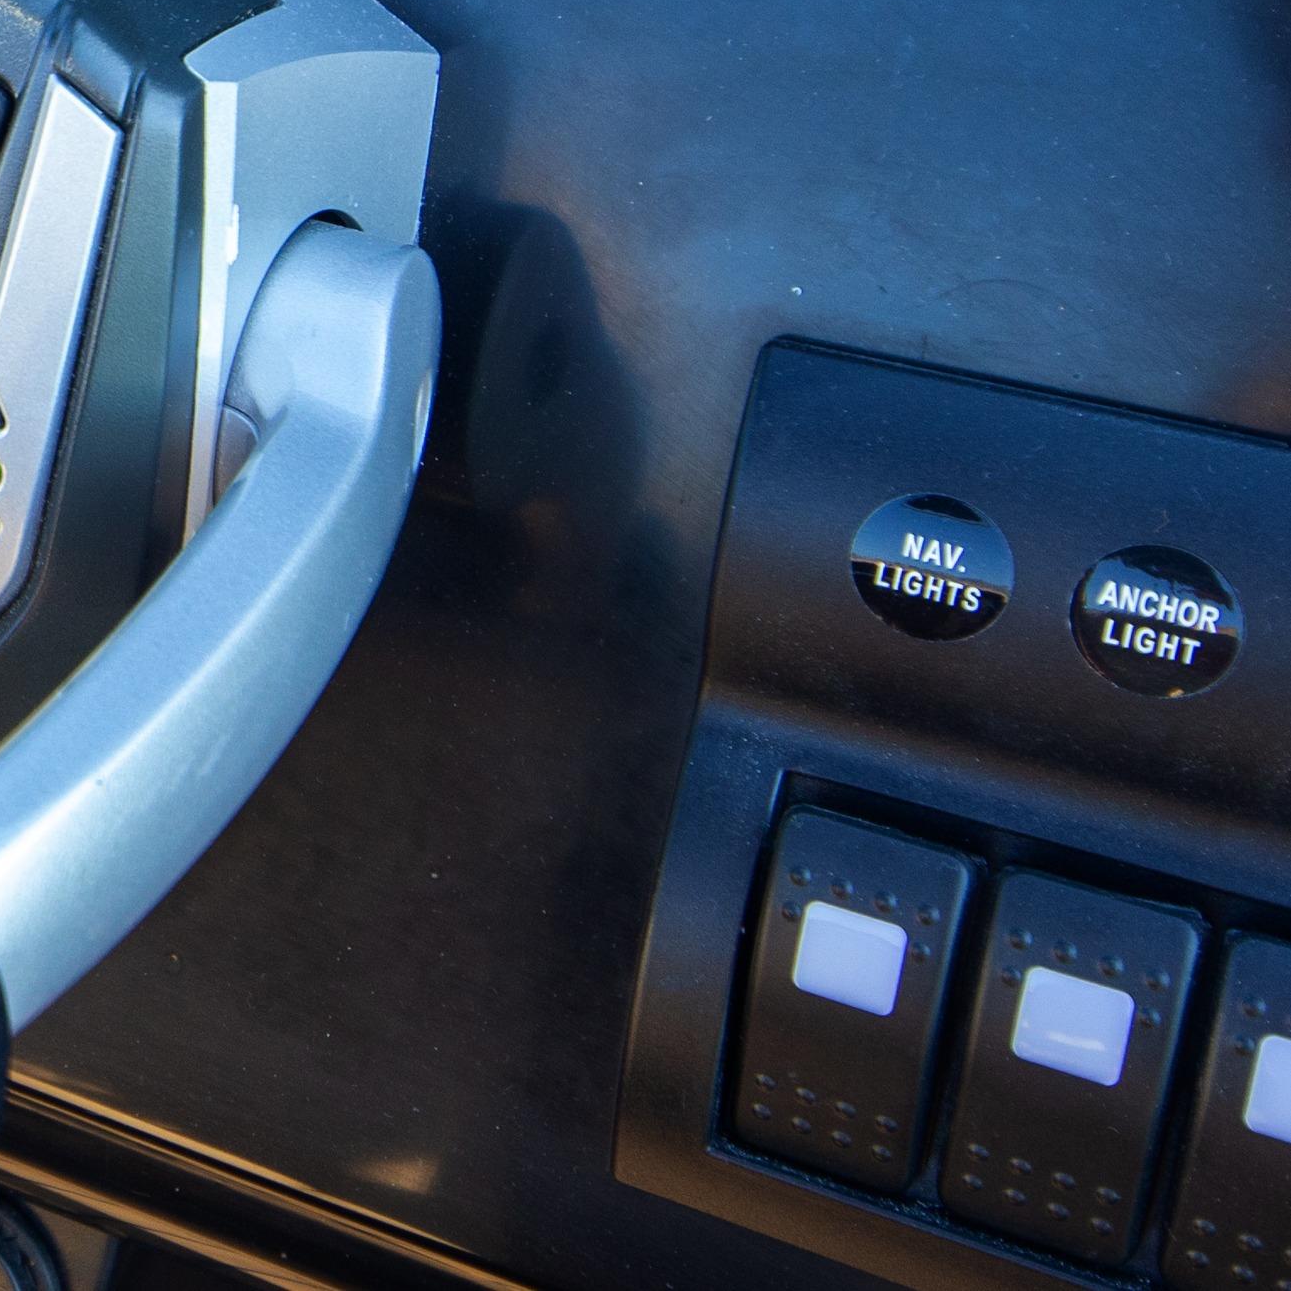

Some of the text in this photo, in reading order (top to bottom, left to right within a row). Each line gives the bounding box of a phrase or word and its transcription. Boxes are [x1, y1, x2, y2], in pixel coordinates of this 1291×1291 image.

[902, 532, 967, 574] NAV.
[873, 561, 983, 613] LIGHTS
[1097, 580, 1221, 634] ANCHOR
[1101, 617, 1202, 666] LIGHT
